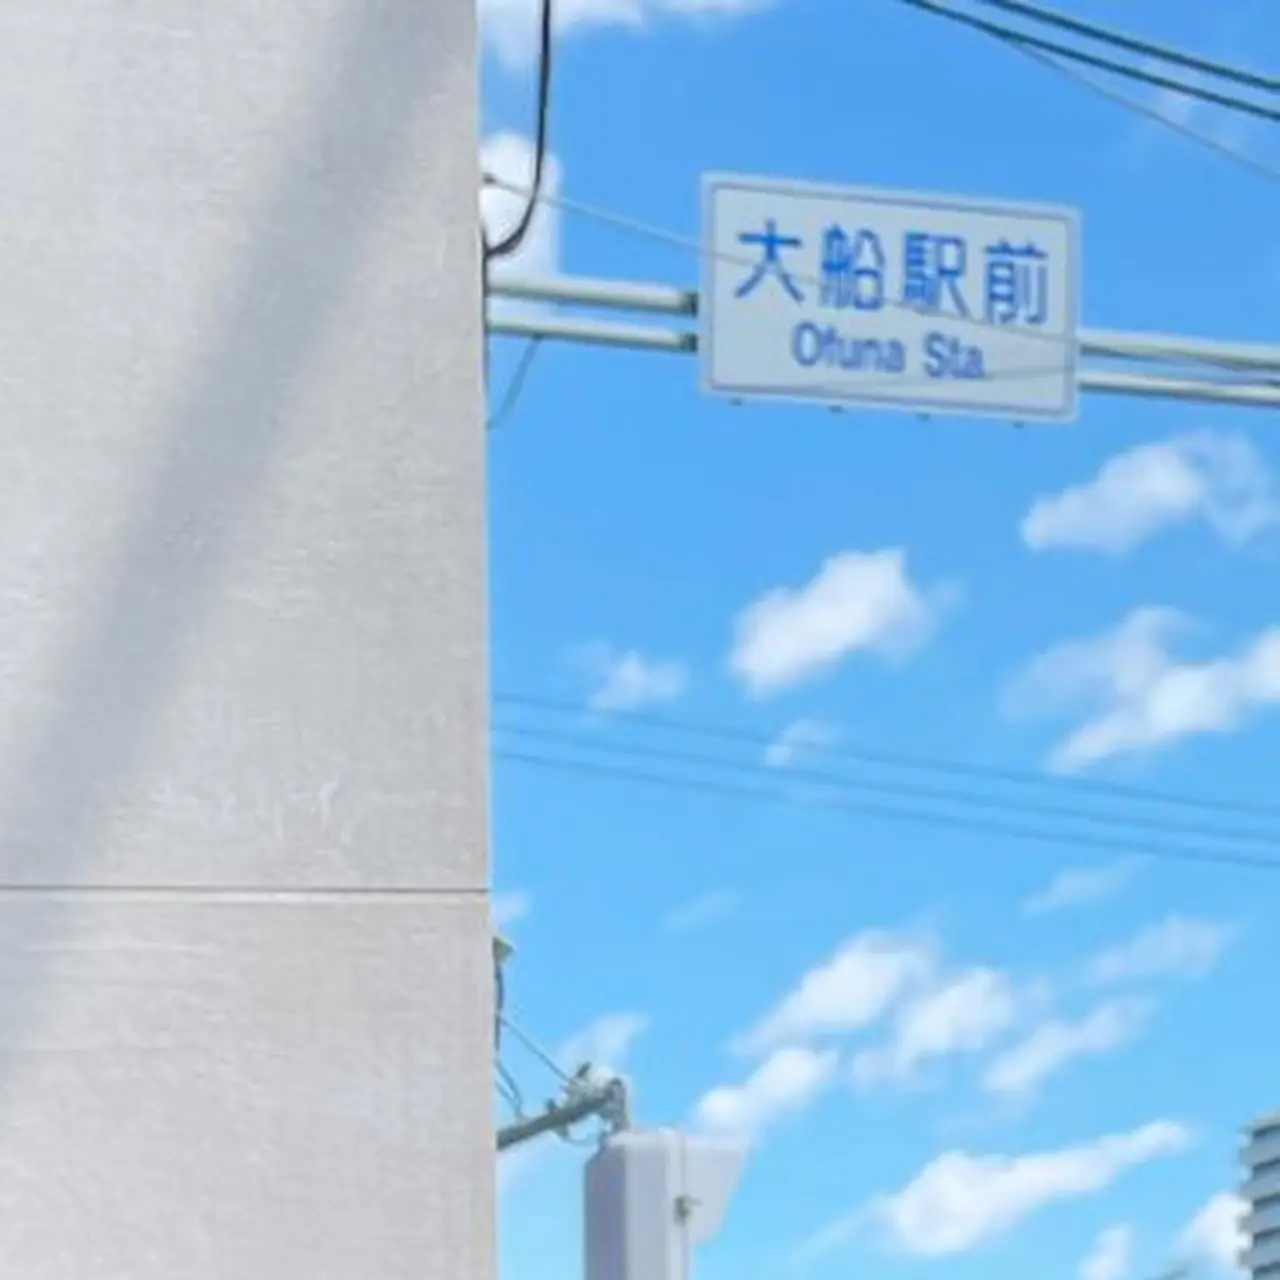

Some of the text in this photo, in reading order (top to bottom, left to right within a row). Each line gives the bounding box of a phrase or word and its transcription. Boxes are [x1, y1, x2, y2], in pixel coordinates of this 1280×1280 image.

[734, 219, 1049, 325] 大船駅前
[793, 321, 905, 374] Ofuna
